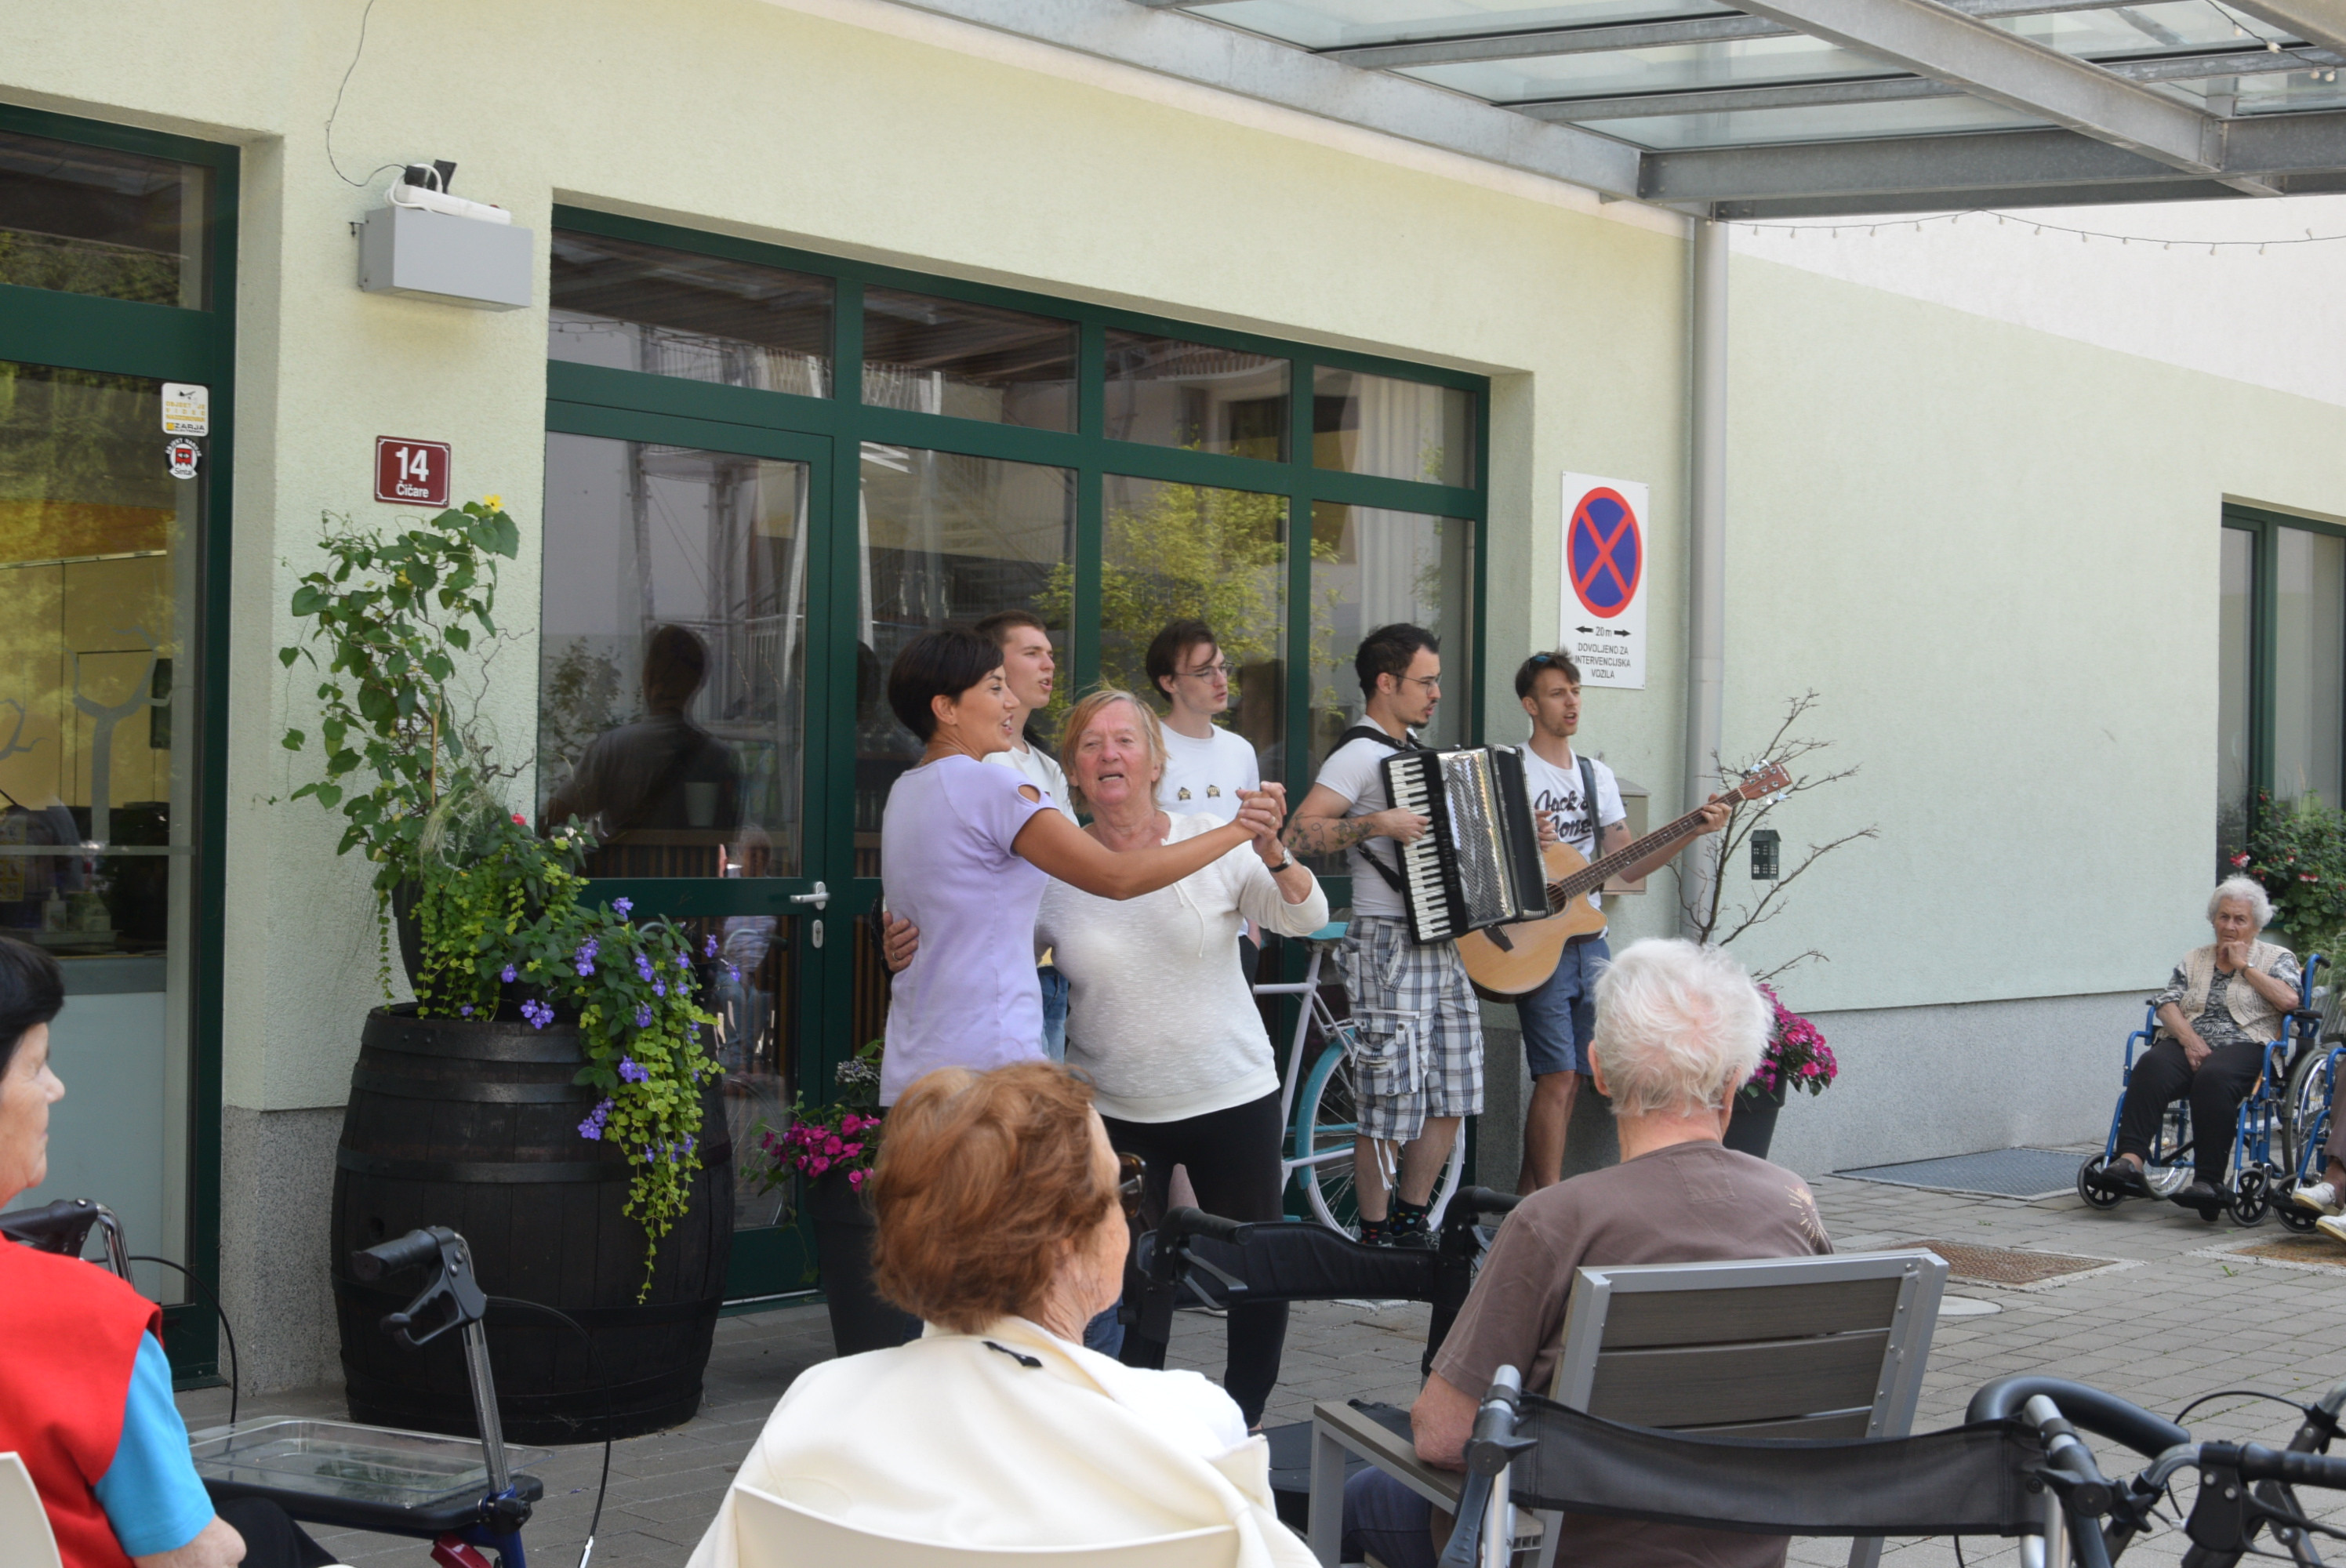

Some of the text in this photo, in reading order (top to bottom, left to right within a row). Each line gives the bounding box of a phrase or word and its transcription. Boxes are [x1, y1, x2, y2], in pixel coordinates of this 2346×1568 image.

[395, 446, 429, 482] 14
[396, 480, 430, 498] Čičare
[1578, 642, 1629, 655] DOVOLJENO ZA
[1575, 655, 1631, 668] INTERVENCIJSKA
[1591, 669, 1615, 679] VOZILA
[1550, 815, 1592, 837] Jone
